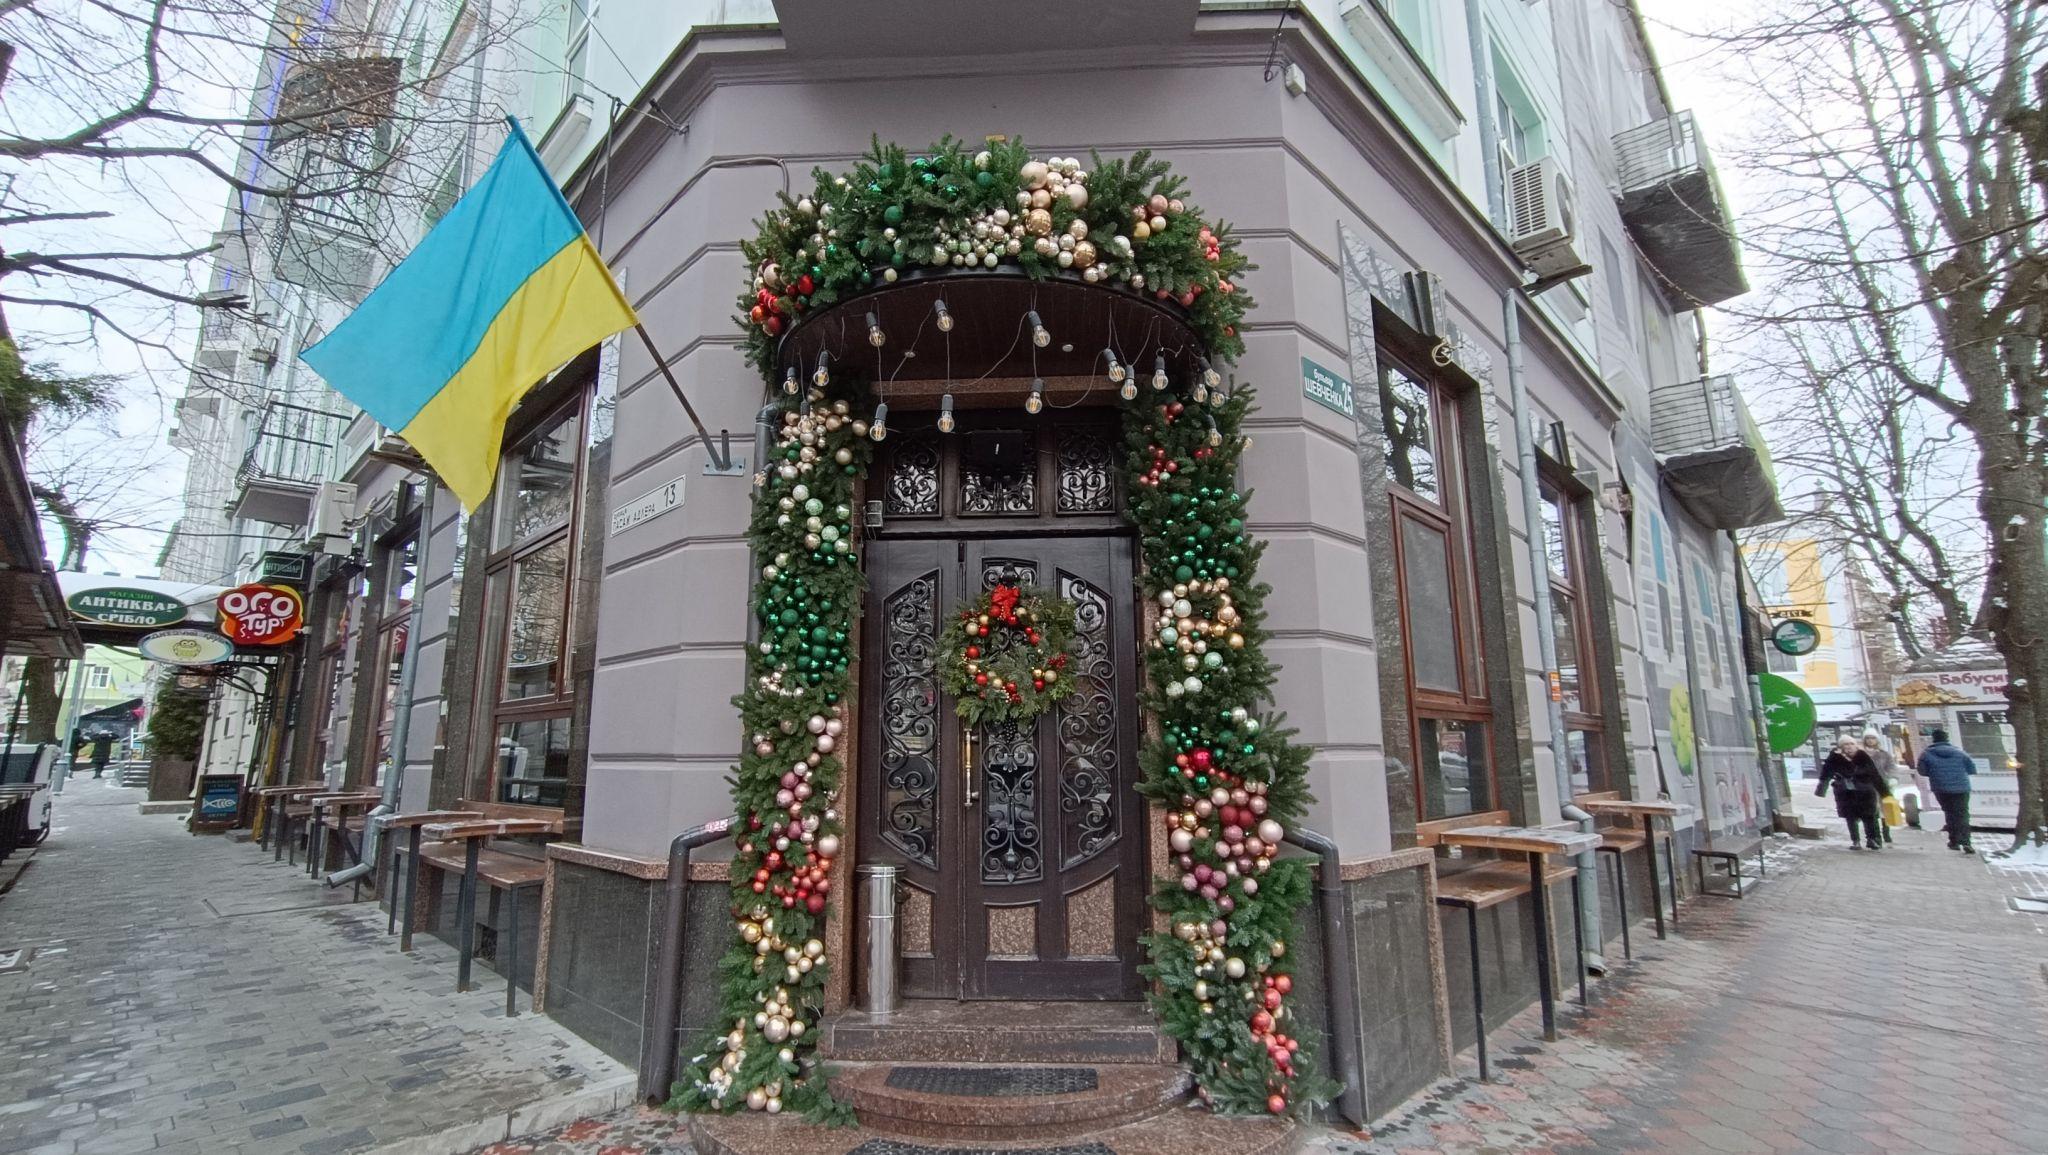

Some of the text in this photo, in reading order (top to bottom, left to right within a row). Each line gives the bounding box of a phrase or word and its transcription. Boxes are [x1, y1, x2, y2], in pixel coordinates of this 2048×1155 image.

[1304, 376, 1353, 416] ШЕВЧЕНКА 25
[664, 483, 676, 507] 13
[79, 595, 178, 613] АНТИКВАР
[109, 591, 154, 600] МАГАЗИН
[223, 591, 294, 617] ОГО
[97, 613, 156, 625] СРІБЛО
